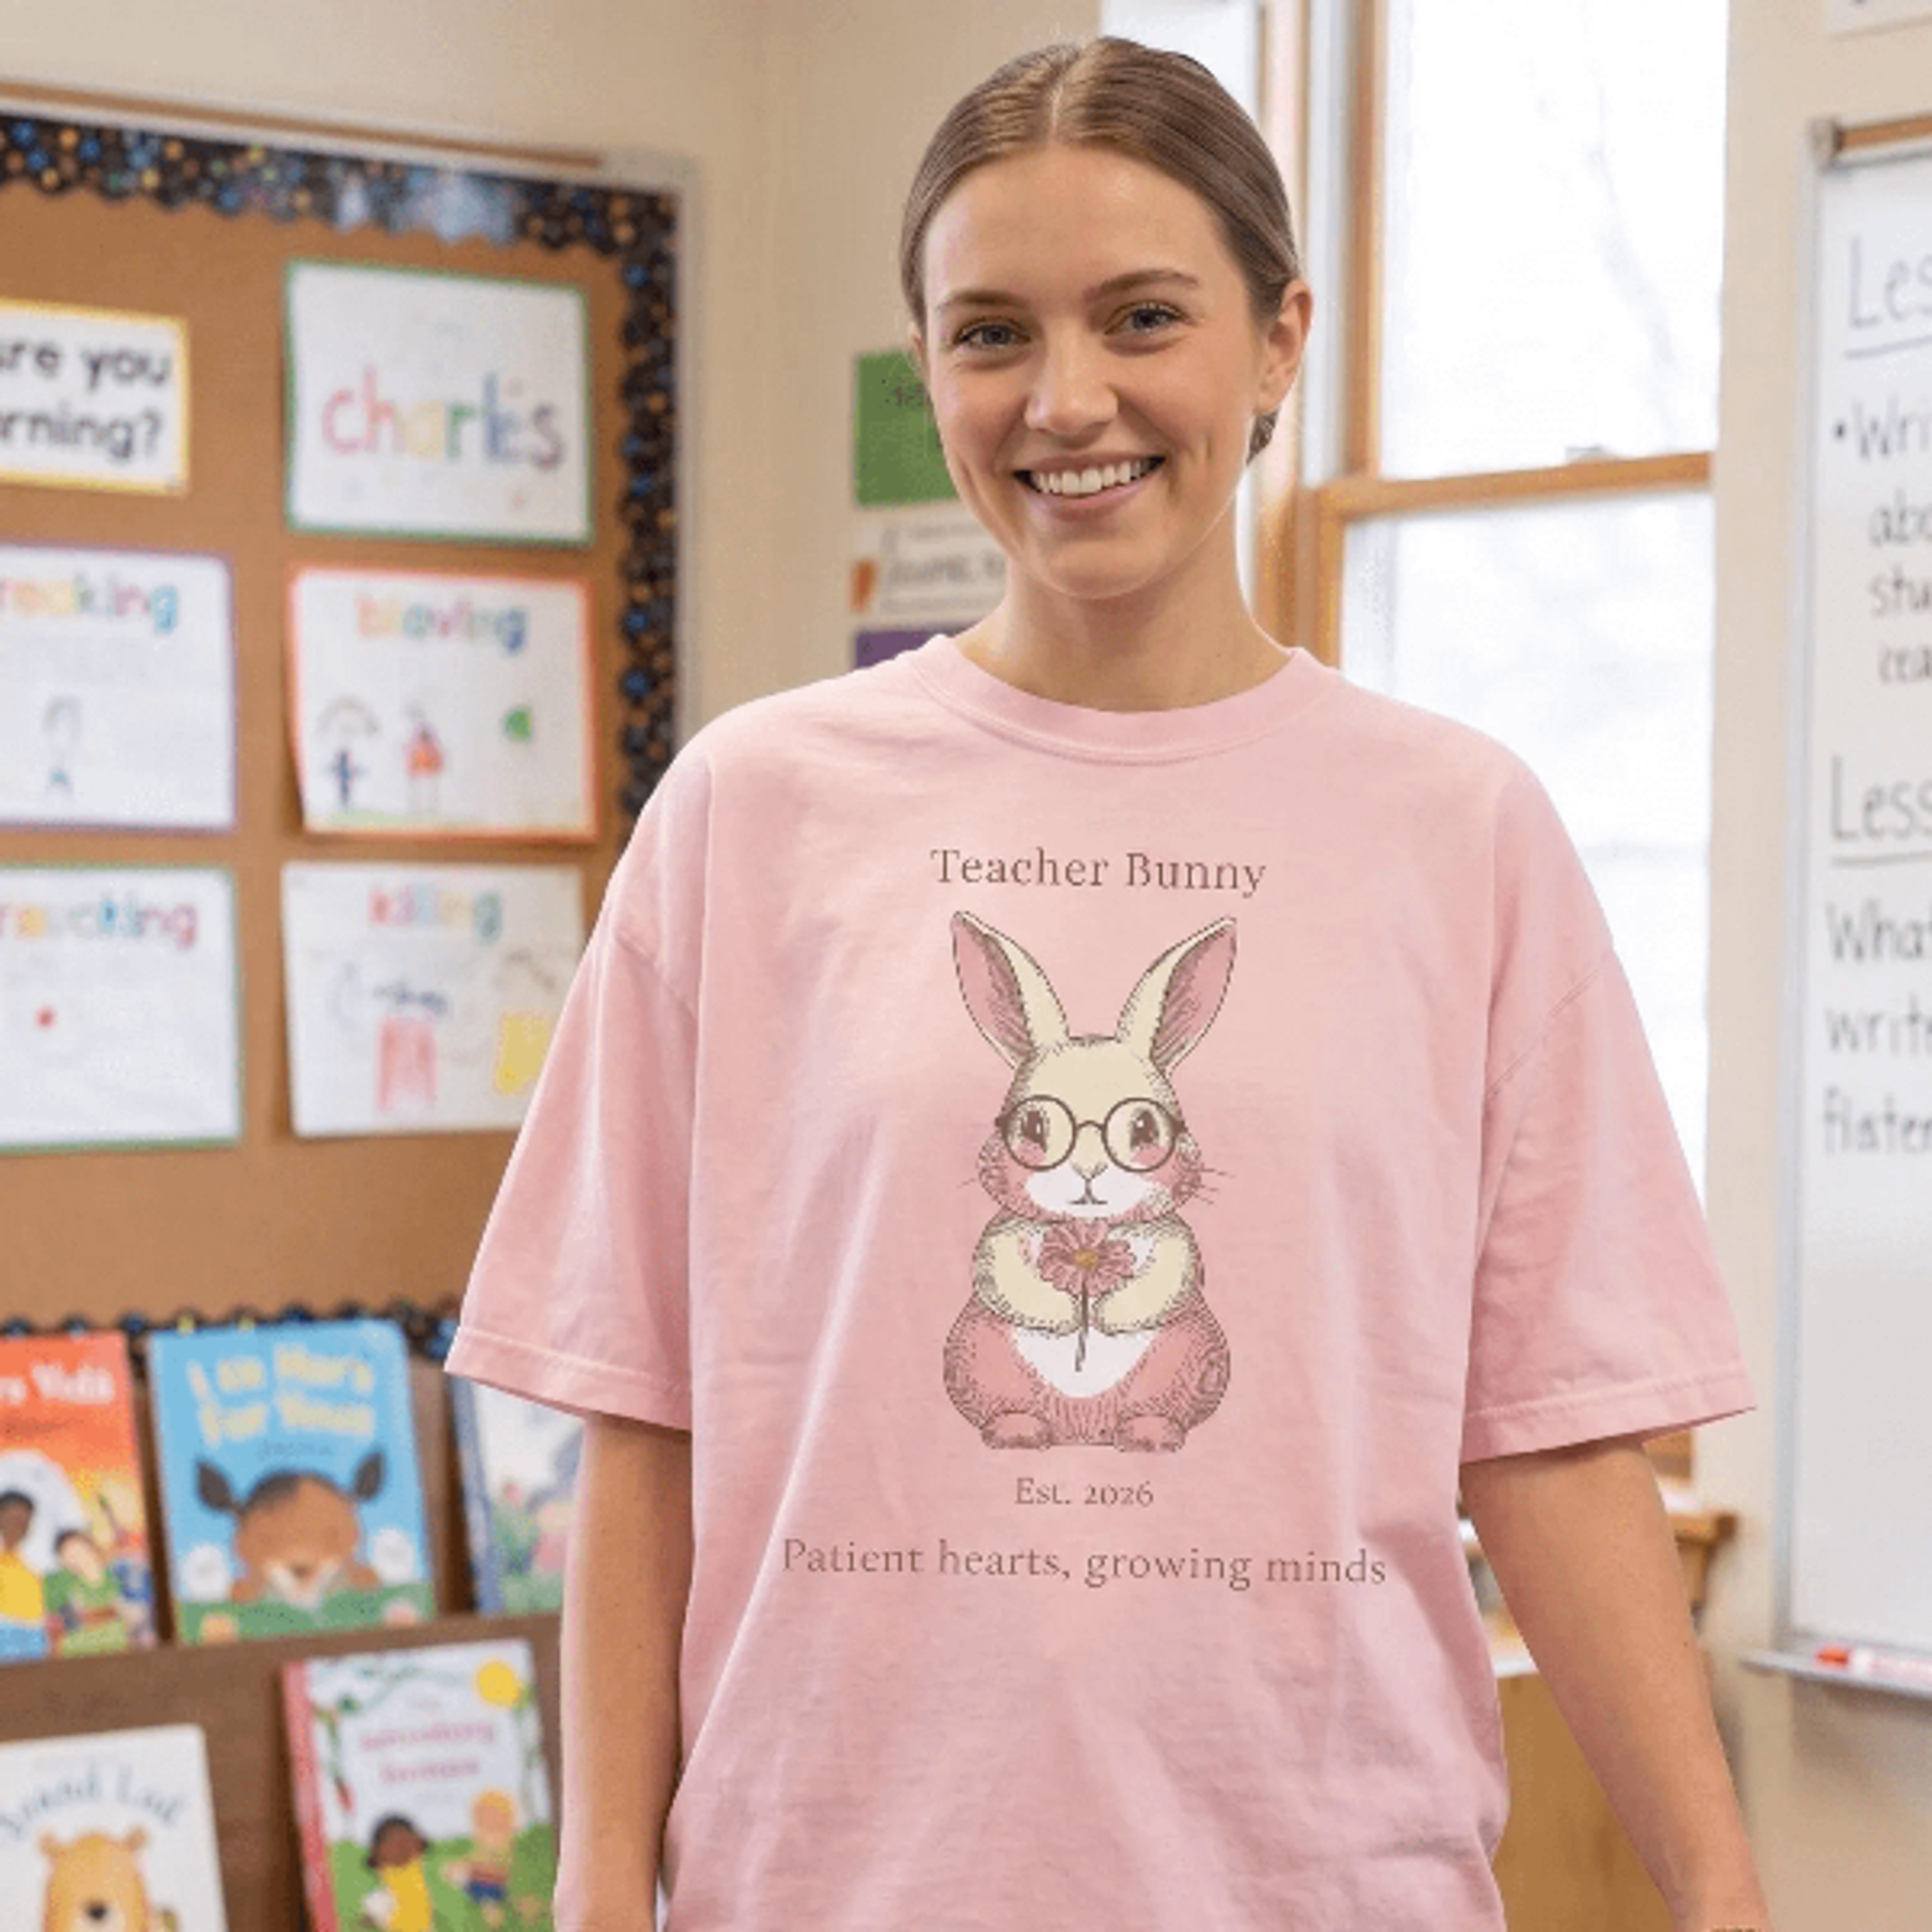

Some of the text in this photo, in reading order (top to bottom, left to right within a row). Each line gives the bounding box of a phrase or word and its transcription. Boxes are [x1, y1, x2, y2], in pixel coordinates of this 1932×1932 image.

[79, 346, 171, 393] you
[930, 846, 1266, 899] Teacher Bunny
[1016, 1478, 1154, 1506] Est. 2026
[784, 1539, 1385, 1591] Patient hearts, growing minds
